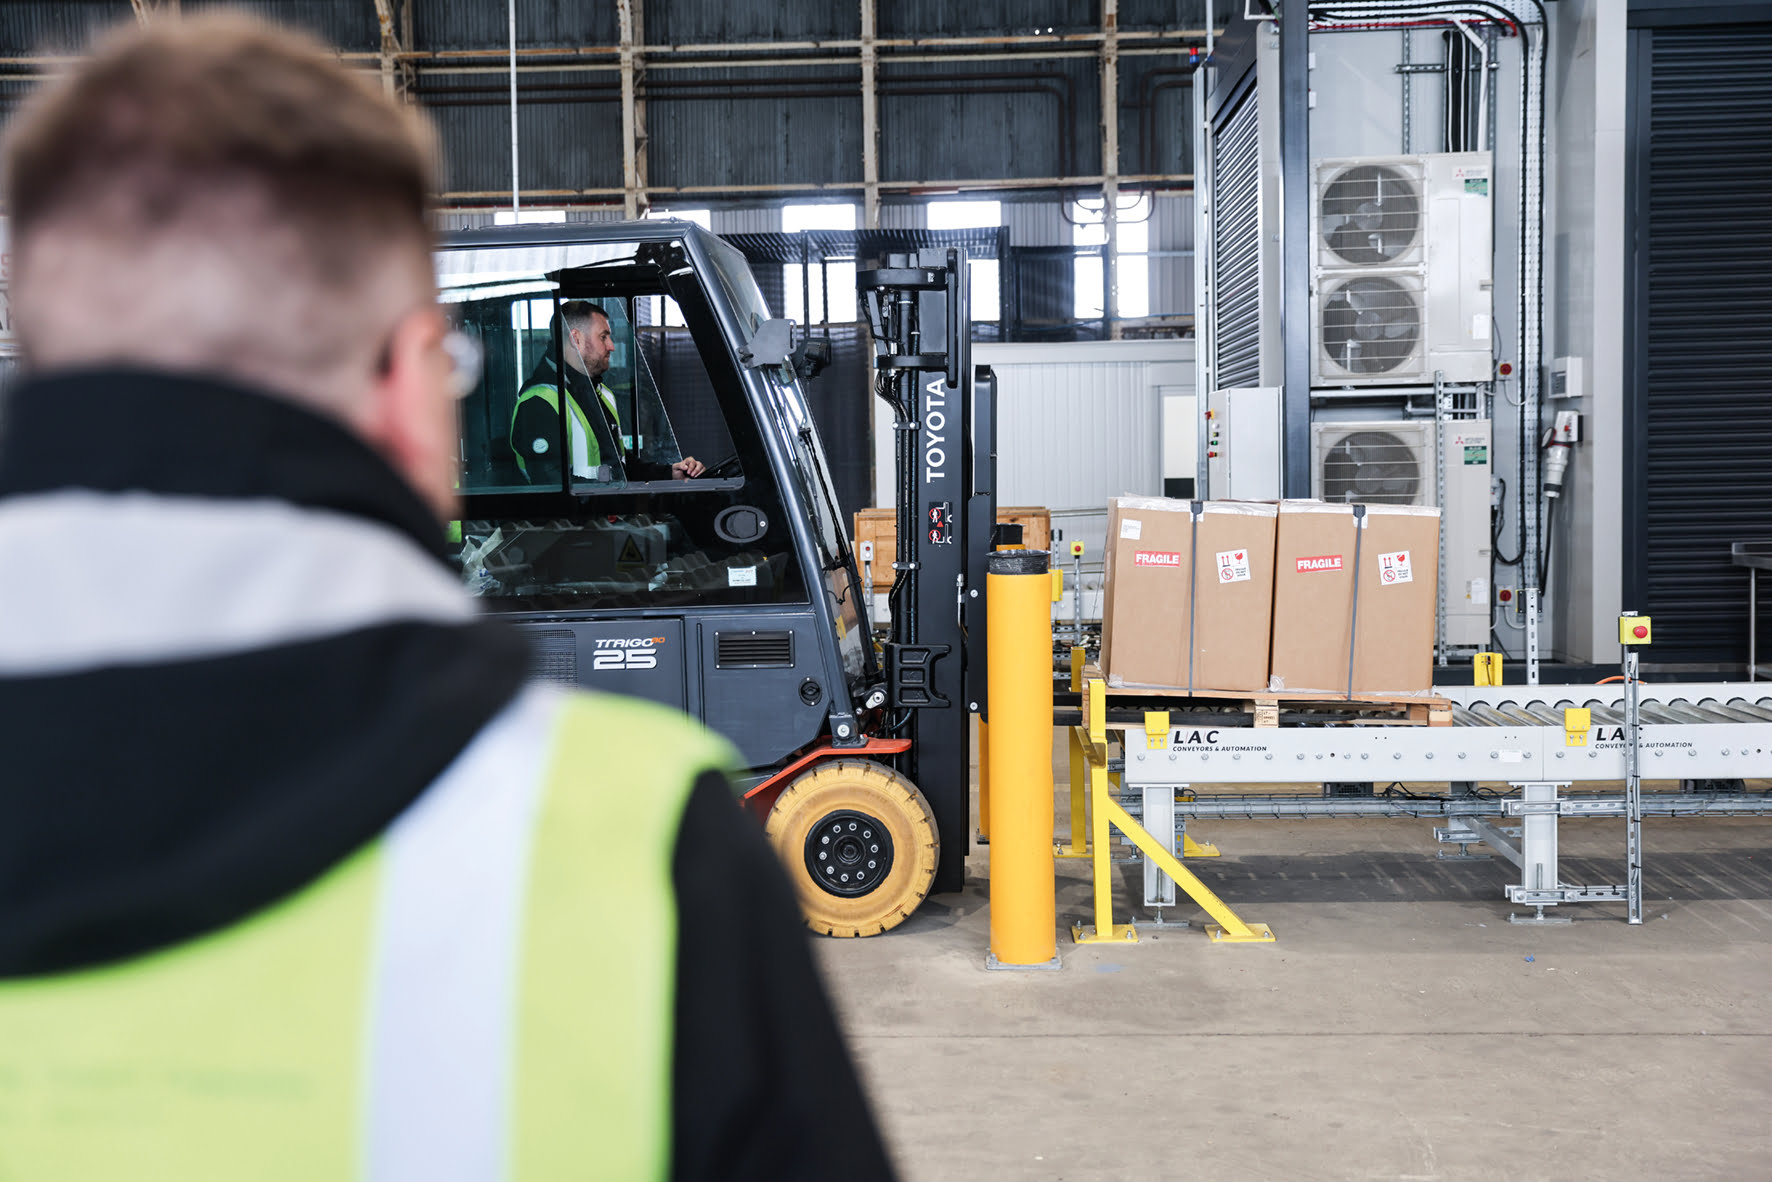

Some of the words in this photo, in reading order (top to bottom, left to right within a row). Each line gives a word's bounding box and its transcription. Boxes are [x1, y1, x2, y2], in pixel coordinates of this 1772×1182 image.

[926, 378, 945, 483] TOYOTA
[1135, 553, 1179, 564] FRAGILE
[1297, 557, 1341, 570] FRAGILE
[593, 649, 657, 670] 25
[1596, 727, 1643, 741] LA
